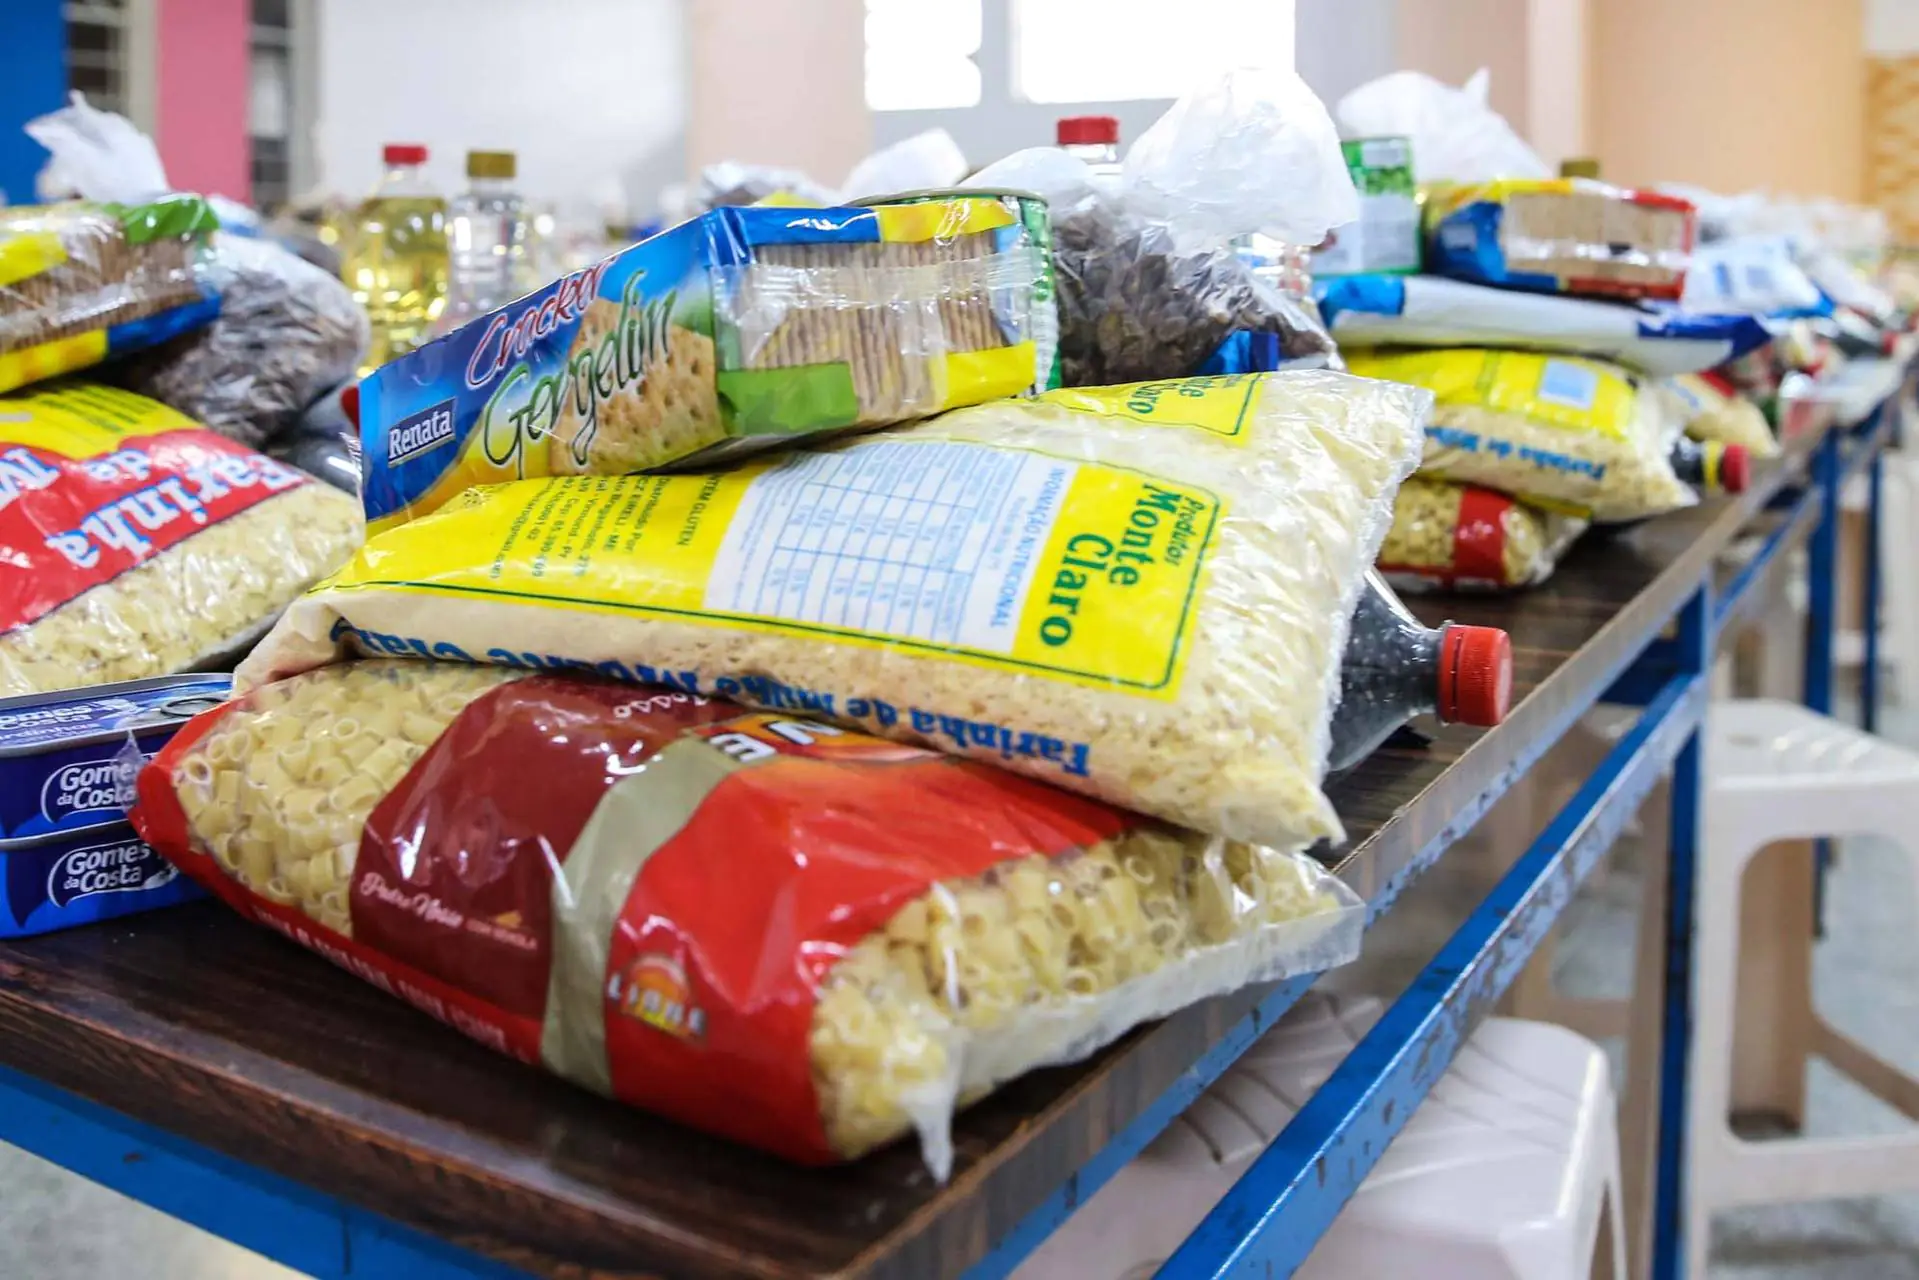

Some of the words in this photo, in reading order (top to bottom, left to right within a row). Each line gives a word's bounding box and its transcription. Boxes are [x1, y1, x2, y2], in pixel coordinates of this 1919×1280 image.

[388, 409, 452, 459] Renata
[46, 453, 304, 569] Farinha
[1109, 482, 1182, 587] Monte
[1165, 496, 1206, 567] Produtor
[1039, 533, 1116, 647] Claro
[0, 705, 92, 723] omes
[846, 696, 898, 726] de
[0, 723, 101, 740] rdinhas
[910, 706, 1091, 777] Farinha
[60, 763, 139, 791] Gome
[57, 792, 73, 806] da
[73, 783, 137, 809] Costa
[66, 843, 151, 875] Gomes
[63, 876, 79, 890] da
[80, 865, 142, 893] Costa
